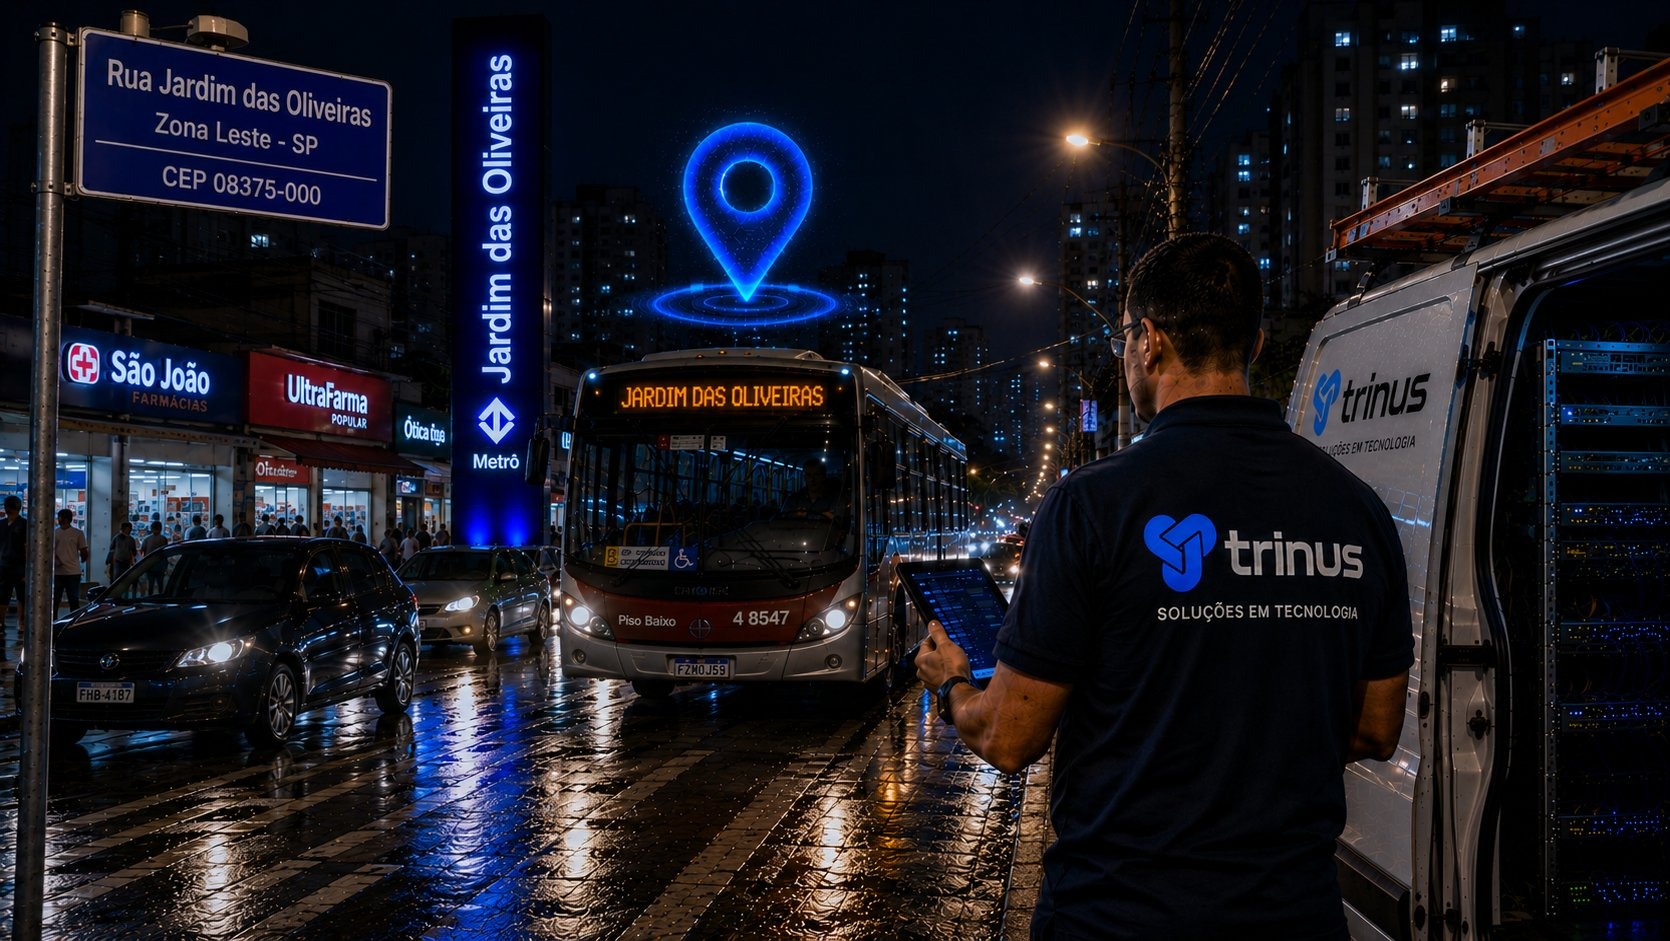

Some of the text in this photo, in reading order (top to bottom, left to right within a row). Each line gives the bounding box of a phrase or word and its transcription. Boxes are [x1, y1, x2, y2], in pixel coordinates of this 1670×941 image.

[107, 58, 372, 127] Rua Jardim das Oliveiras
[155, 112, 209, 140] Zona
[216, 121, 271, 149] Leste
[292, 134, 319, 156] SP
[162, 164, 322, 205] CEP 08375-000
[482, 55, 512, 384] Jardim das Oliveiras
[111, 350, 210, 395] São João
[132, 390, 208, 412] FARMÁCIAS
[287, 373, 368, 415] UltraFarma
[621, 385, 824, 408] JARDIM DAS OLIVEIRAS
[1341, 372, 1431, 423] trinus
[331, 413, 367, 429] POPULAR
[1351, 441, 1363, 454] EM
[1364, 435, 1416, 453] TECNOLOGIA
[473, 453, 520, 469] Metrô
[1224, 530, 1363, 579] trinus
[618, 614, 677, 627] Piso Baixo
[733, 610, 790, 626] 4 8547
[1157, 601, 1358, 623] SOLUÇÕES EM TECNOLOGIA
[79, 689, 131, 701] FHB-4187
